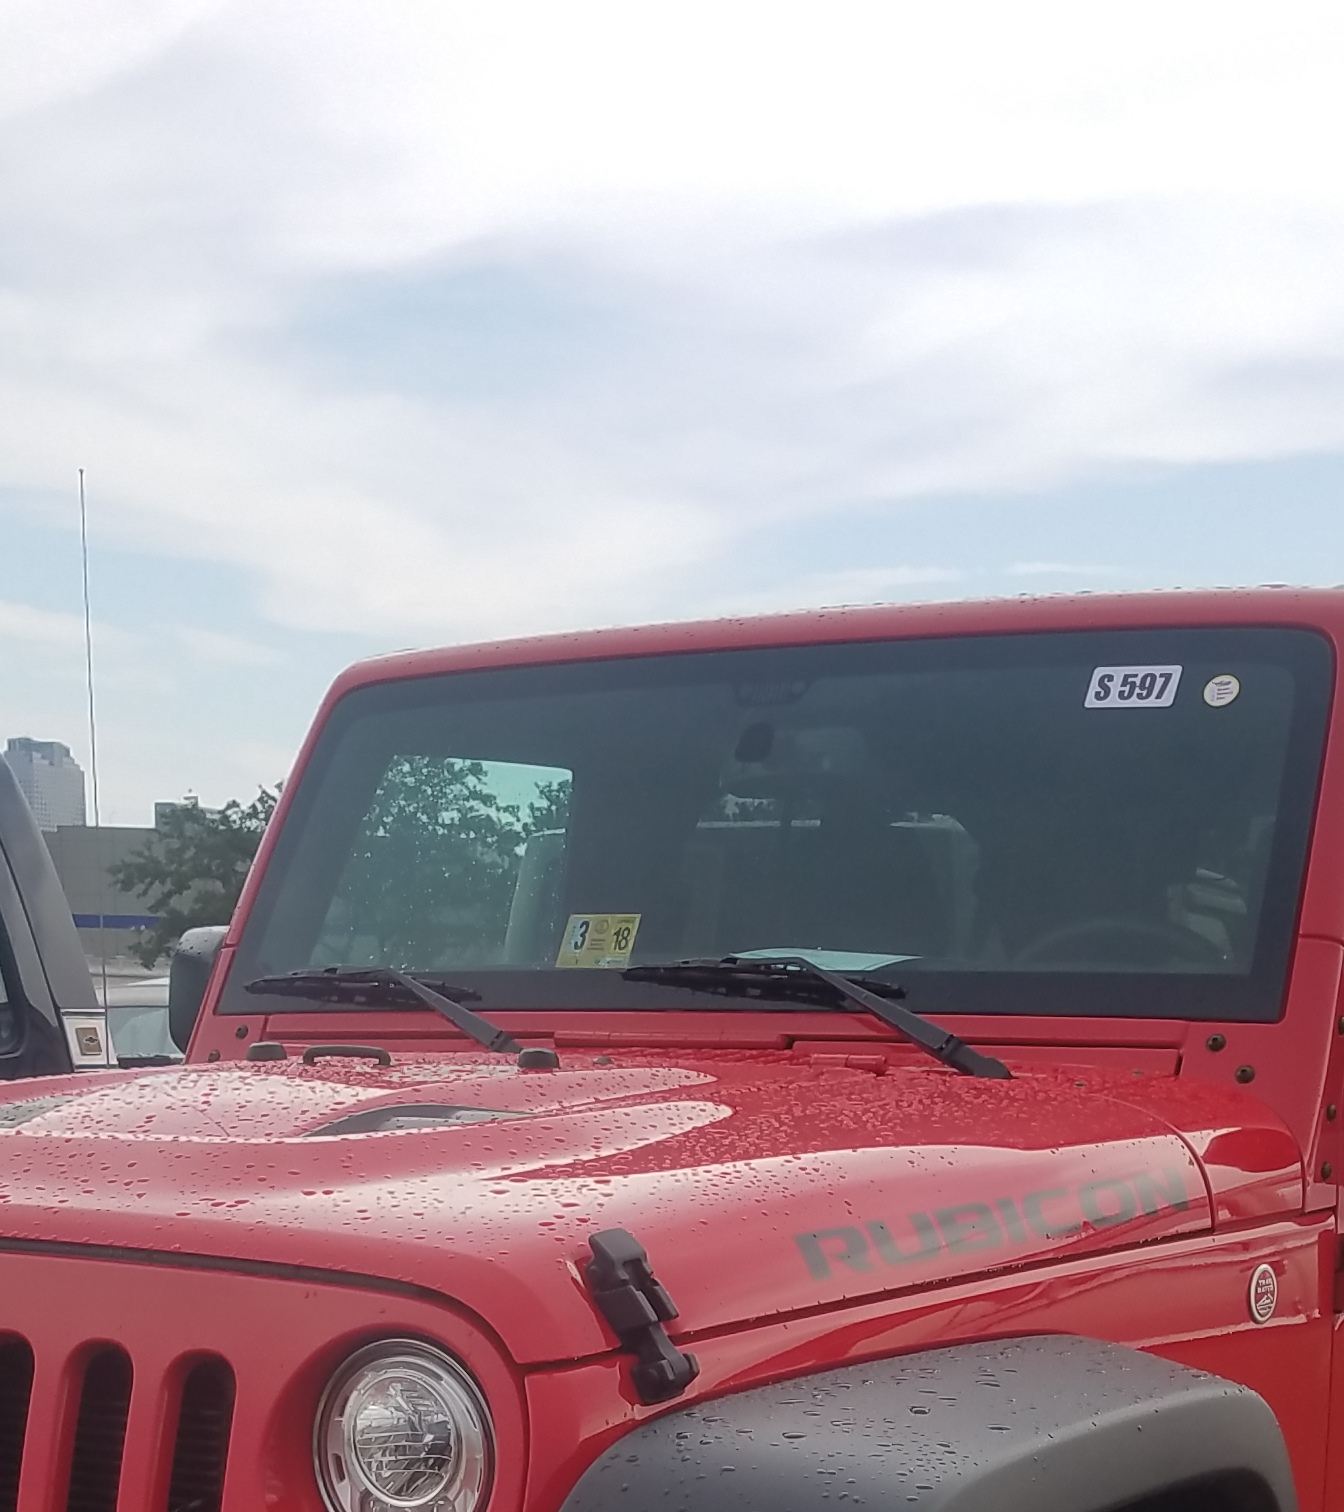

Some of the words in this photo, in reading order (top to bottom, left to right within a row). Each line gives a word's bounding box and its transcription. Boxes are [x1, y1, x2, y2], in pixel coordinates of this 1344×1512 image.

[1094, 673, 1114, 701] S
[1118, 672, 1173, 701] 597
[574, 920, 590, 951] 3
[613, 927, 631, 951] 18
[793, 1168, 1190, 1281] RUBICON
